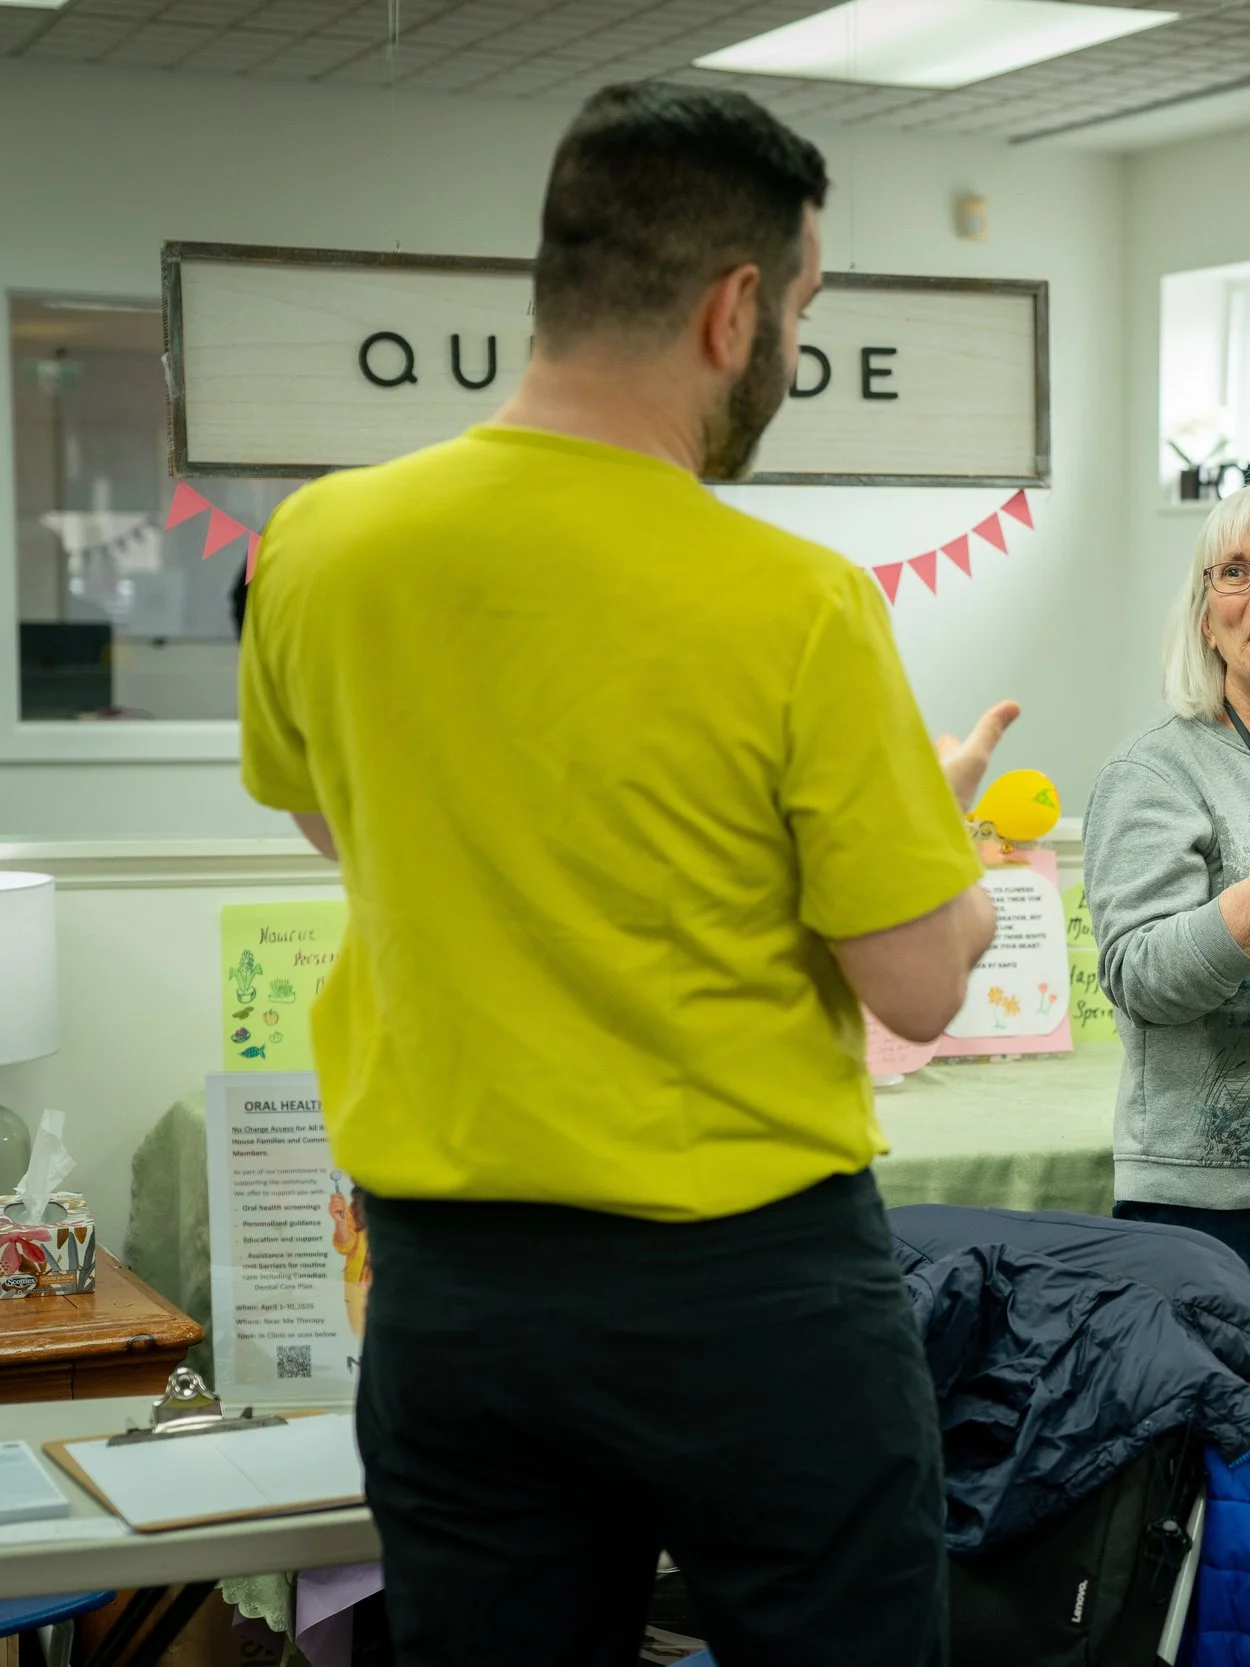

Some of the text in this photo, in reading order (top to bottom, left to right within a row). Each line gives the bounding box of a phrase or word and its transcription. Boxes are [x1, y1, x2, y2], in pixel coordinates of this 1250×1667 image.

[244, 1101, 277, 1111] ORAL
[284, 1204, 321, 1212] screenings
[289, 1219, 321, 1228] guidance
[294, 1251, 328, 1259] removing
[260, 1273, 291, 1281] including
[296, 1317, 325, 1325] Therapy
